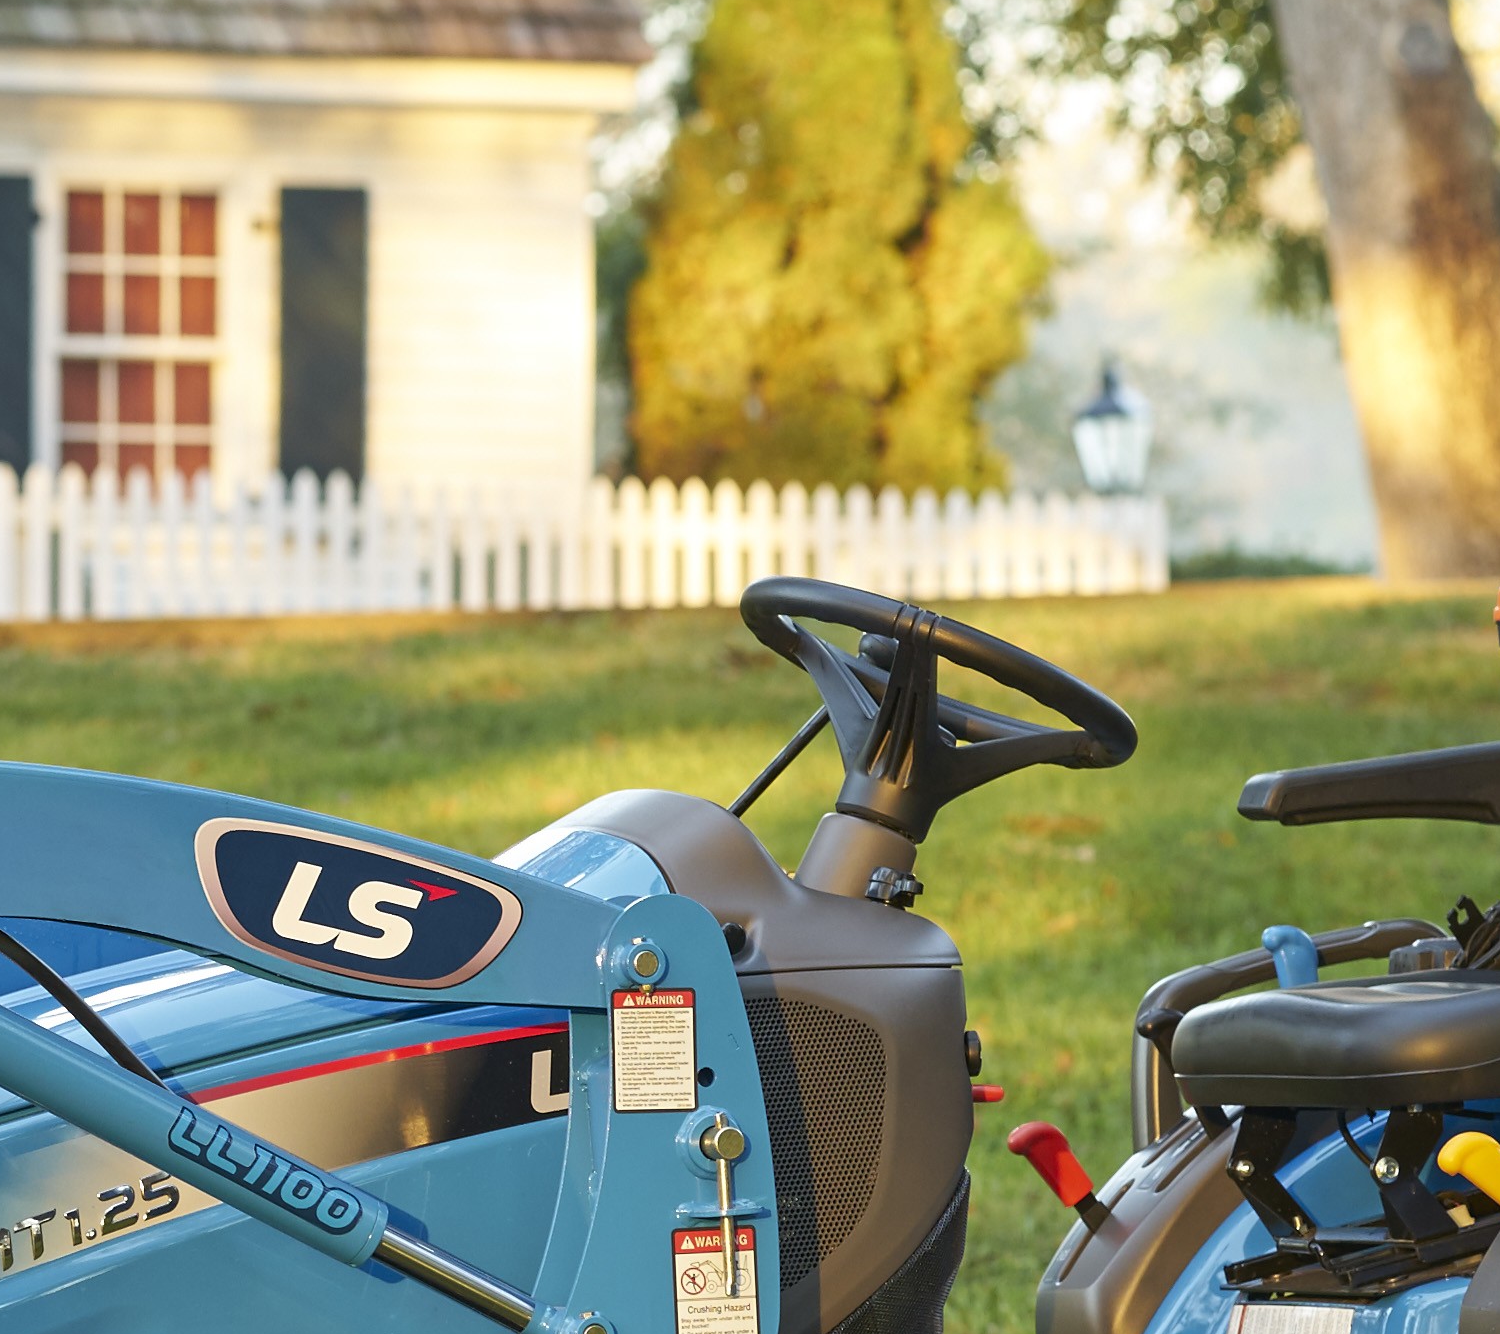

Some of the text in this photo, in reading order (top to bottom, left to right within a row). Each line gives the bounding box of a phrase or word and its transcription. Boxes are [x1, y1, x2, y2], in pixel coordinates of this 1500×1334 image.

[272, 861, 424, 960] LS
[635, 995, 684, 1005] WARNING
[168, 1106, 363, 1234] LL1100
[695, 1234, 748, 1247] WARG
[688, 1304, 750, 1314] Crushing Hazard
